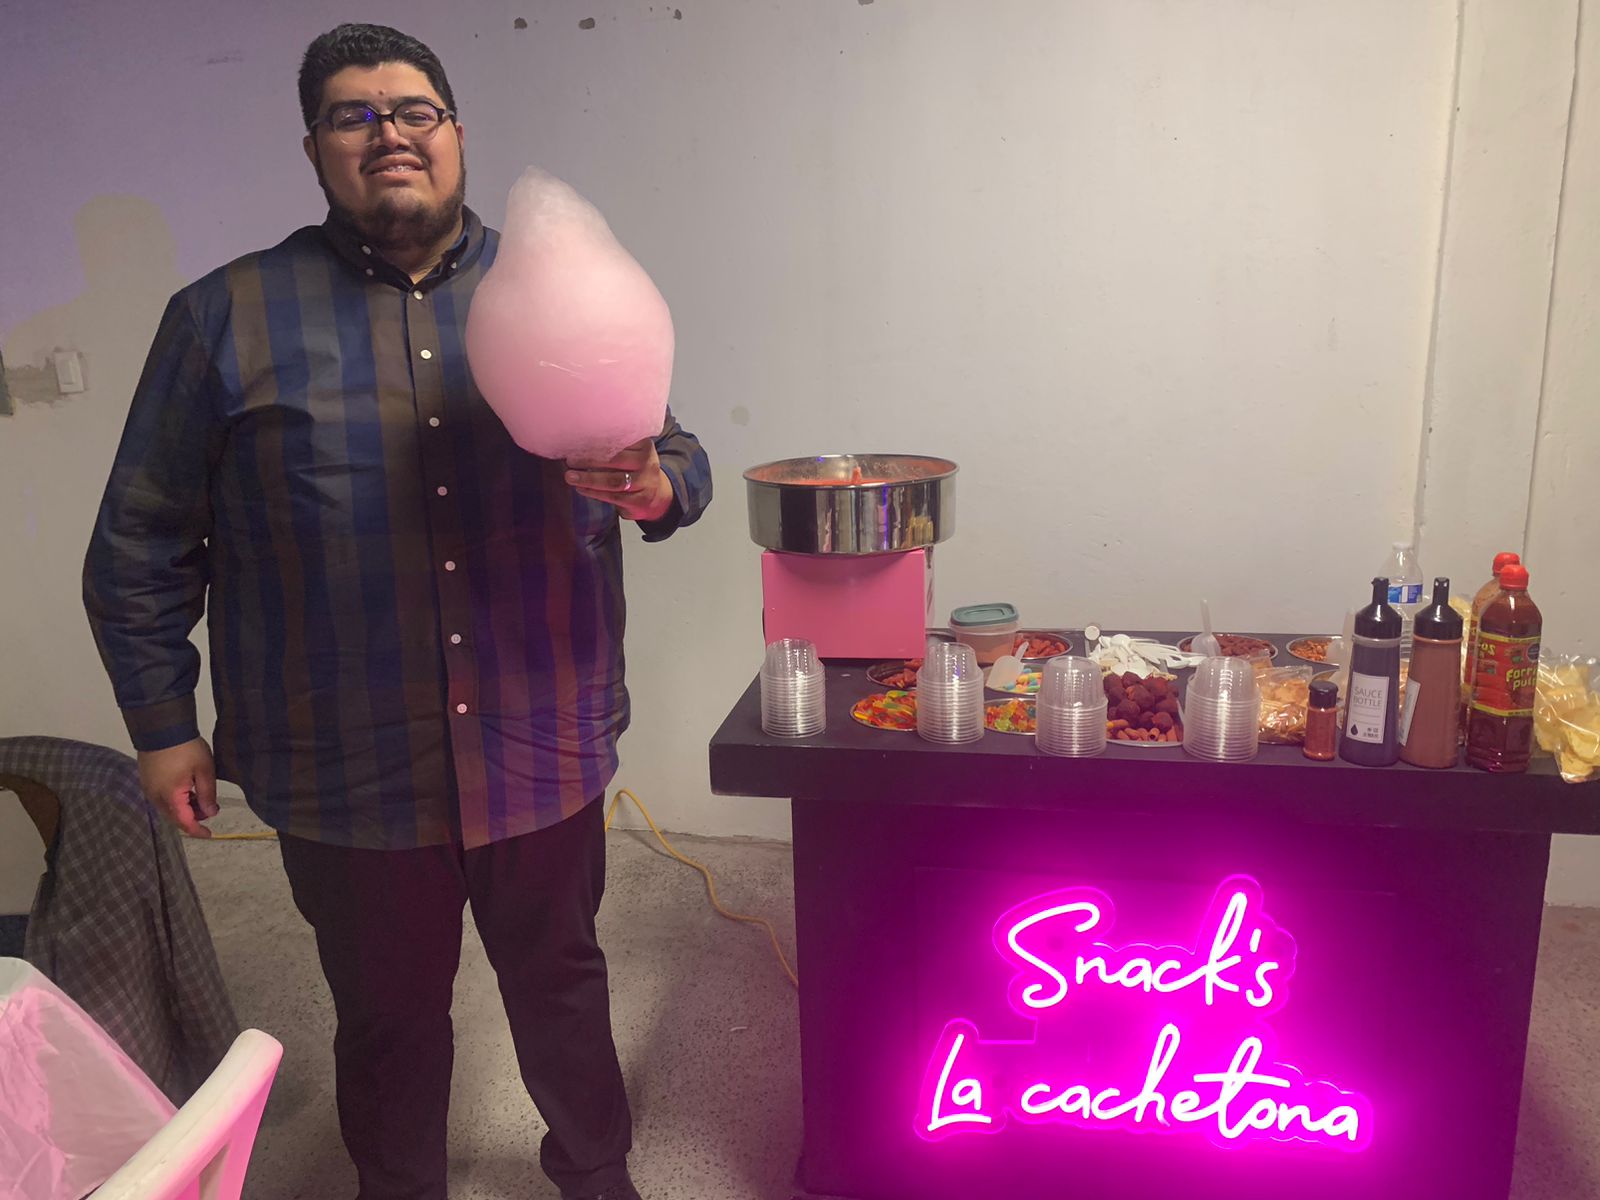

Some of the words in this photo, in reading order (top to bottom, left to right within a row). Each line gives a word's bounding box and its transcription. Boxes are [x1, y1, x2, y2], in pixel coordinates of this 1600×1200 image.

[1353, 686, 1383, 699] SAUCE
[1353, 695, 1383, 707] BOTTLE
[1006, 890, 1280, 1009] Snack's
[926, 1032, 993, 1132] La
[1020, 1022, 1360, 1142] cachetona
